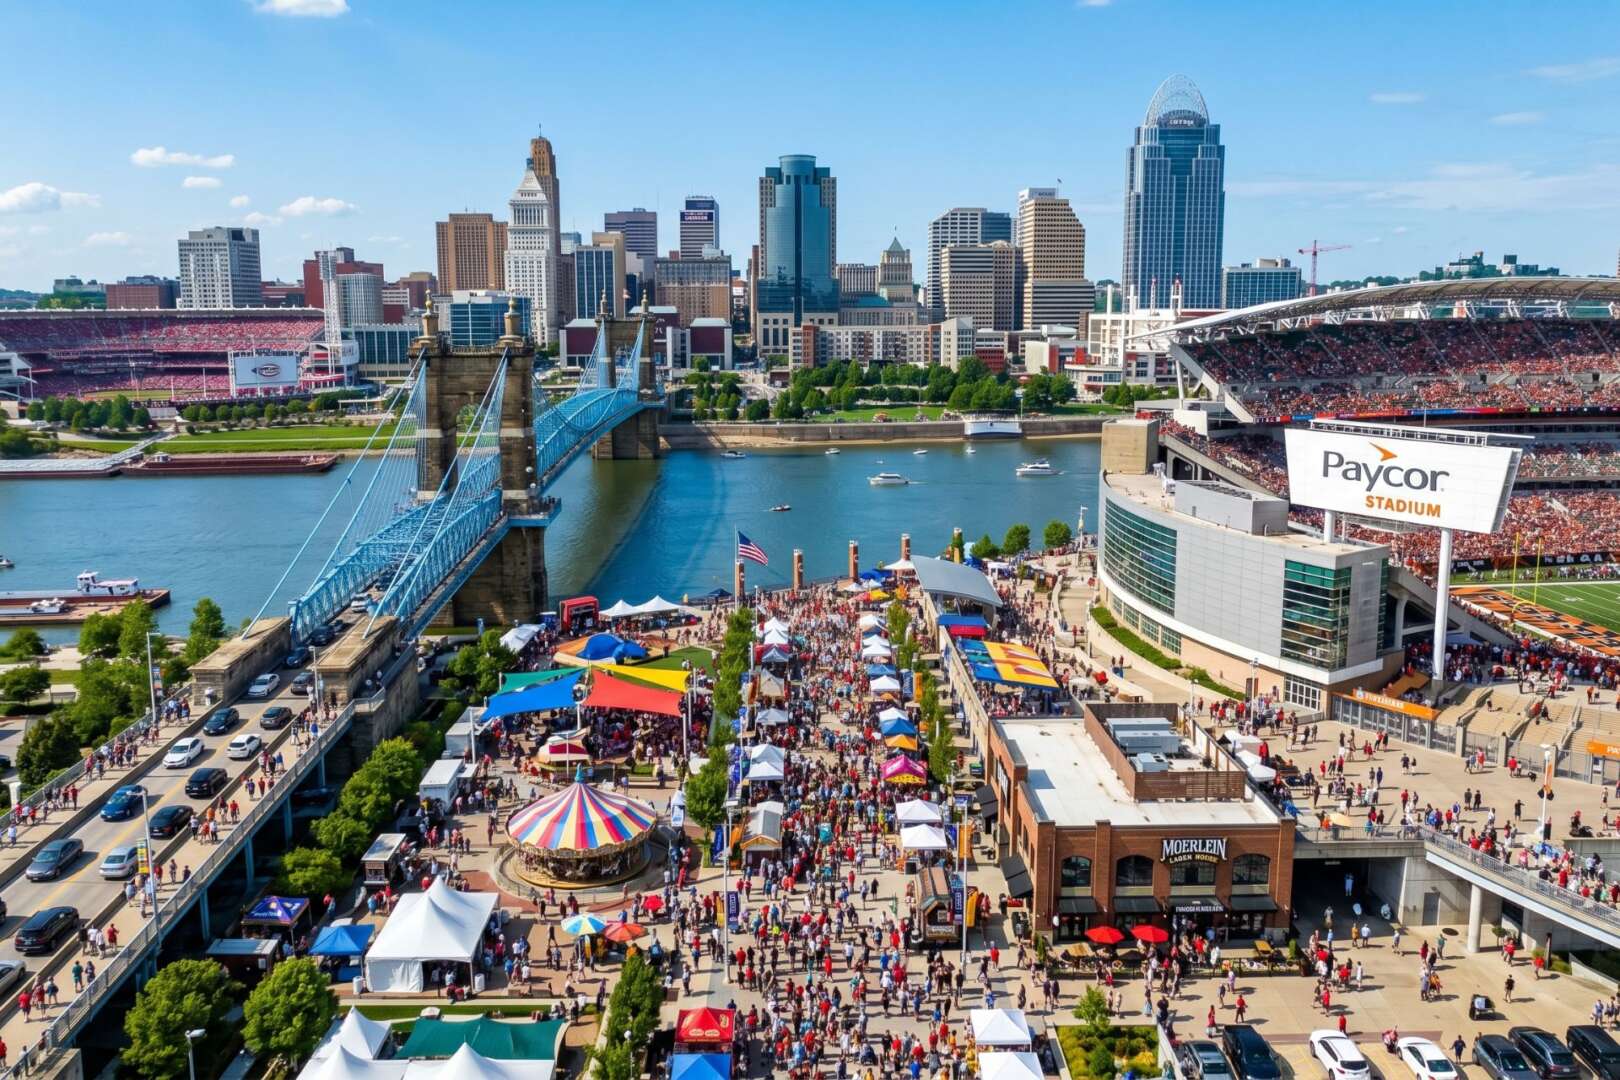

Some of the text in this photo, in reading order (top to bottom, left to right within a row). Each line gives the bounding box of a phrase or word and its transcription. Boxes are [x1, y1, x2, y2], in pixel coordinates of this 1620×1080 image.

[1322, 450, 1450, 492] Paycor
[1365, 495, 1441, 518] STADIUM
[1160, 837, 1228, 862] MOERLEIN
